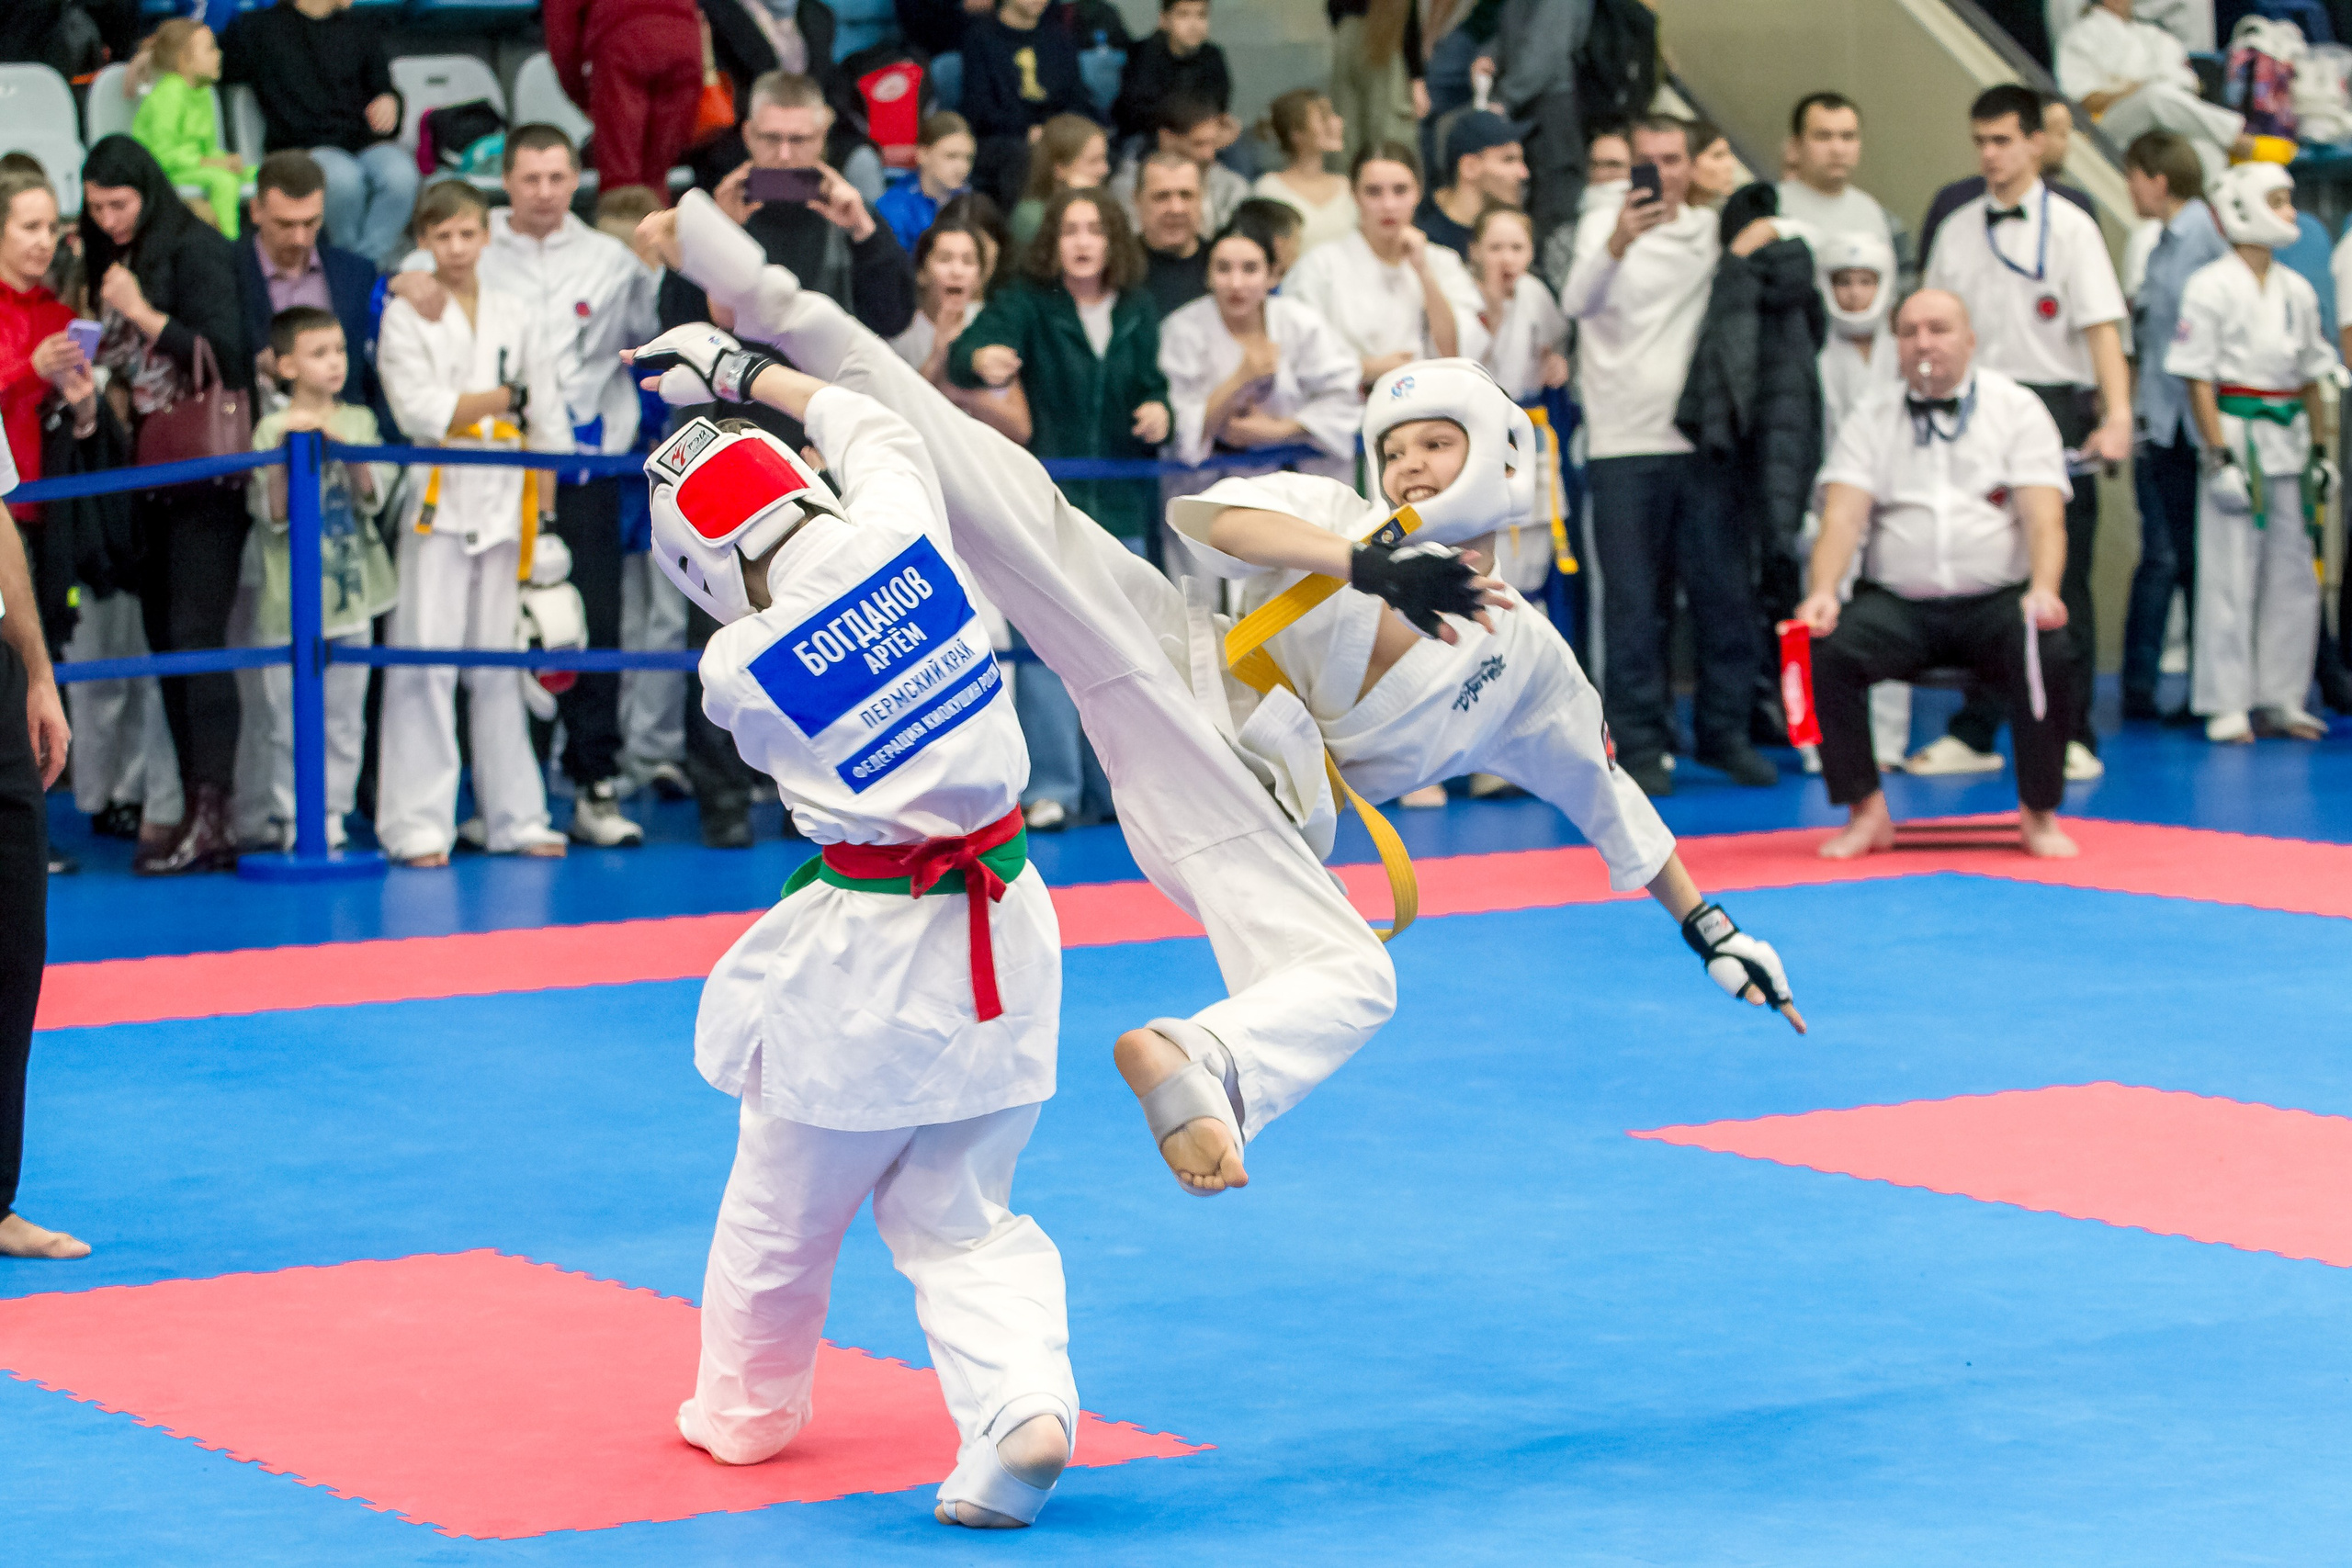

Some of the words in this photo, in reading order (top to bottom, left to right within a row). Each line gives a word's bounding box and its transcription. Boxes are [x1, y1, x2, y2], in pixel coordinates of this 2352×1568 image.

[792, 566, 933, 677] БОГДАНОВ
[862, 622, 928, 675] АРТЁМ
[858, 658, 946, 729] ПЕРМСКИЙ
[940, 637, 976, 673] КРАЙ
[853, 721, 928, 778] ФЕДЕРАЦИЯ
